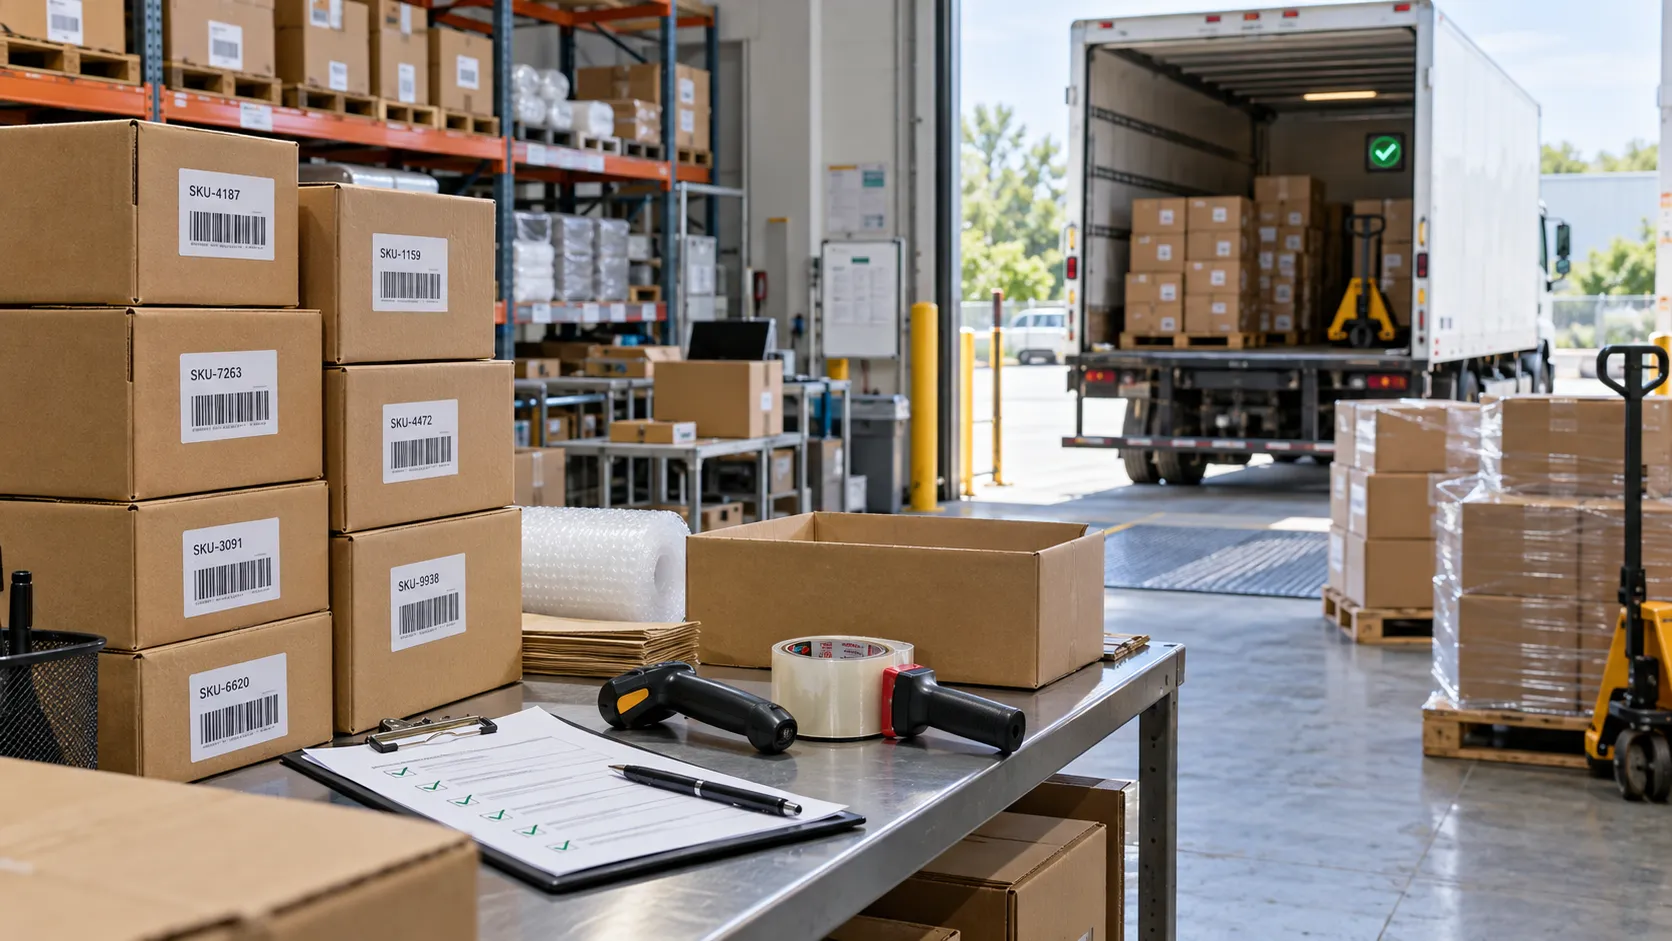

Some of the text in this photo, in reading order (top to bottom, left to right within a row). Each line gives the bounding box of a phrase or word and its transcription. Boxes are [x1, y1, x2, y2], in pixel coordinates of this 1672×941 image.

[189, 185, 241, 201] SKU-4187
[380, 247, 421, 261] SKU-1159
[190, 367, 242, 382] SKU-7263
[390, 414, 433, 429] SKU-4472
[193, 537, 243, 556] SKU-3091
[398, 572, 440, 592] SKU-9938
[199, 676, 250, 700] SKU-6620
